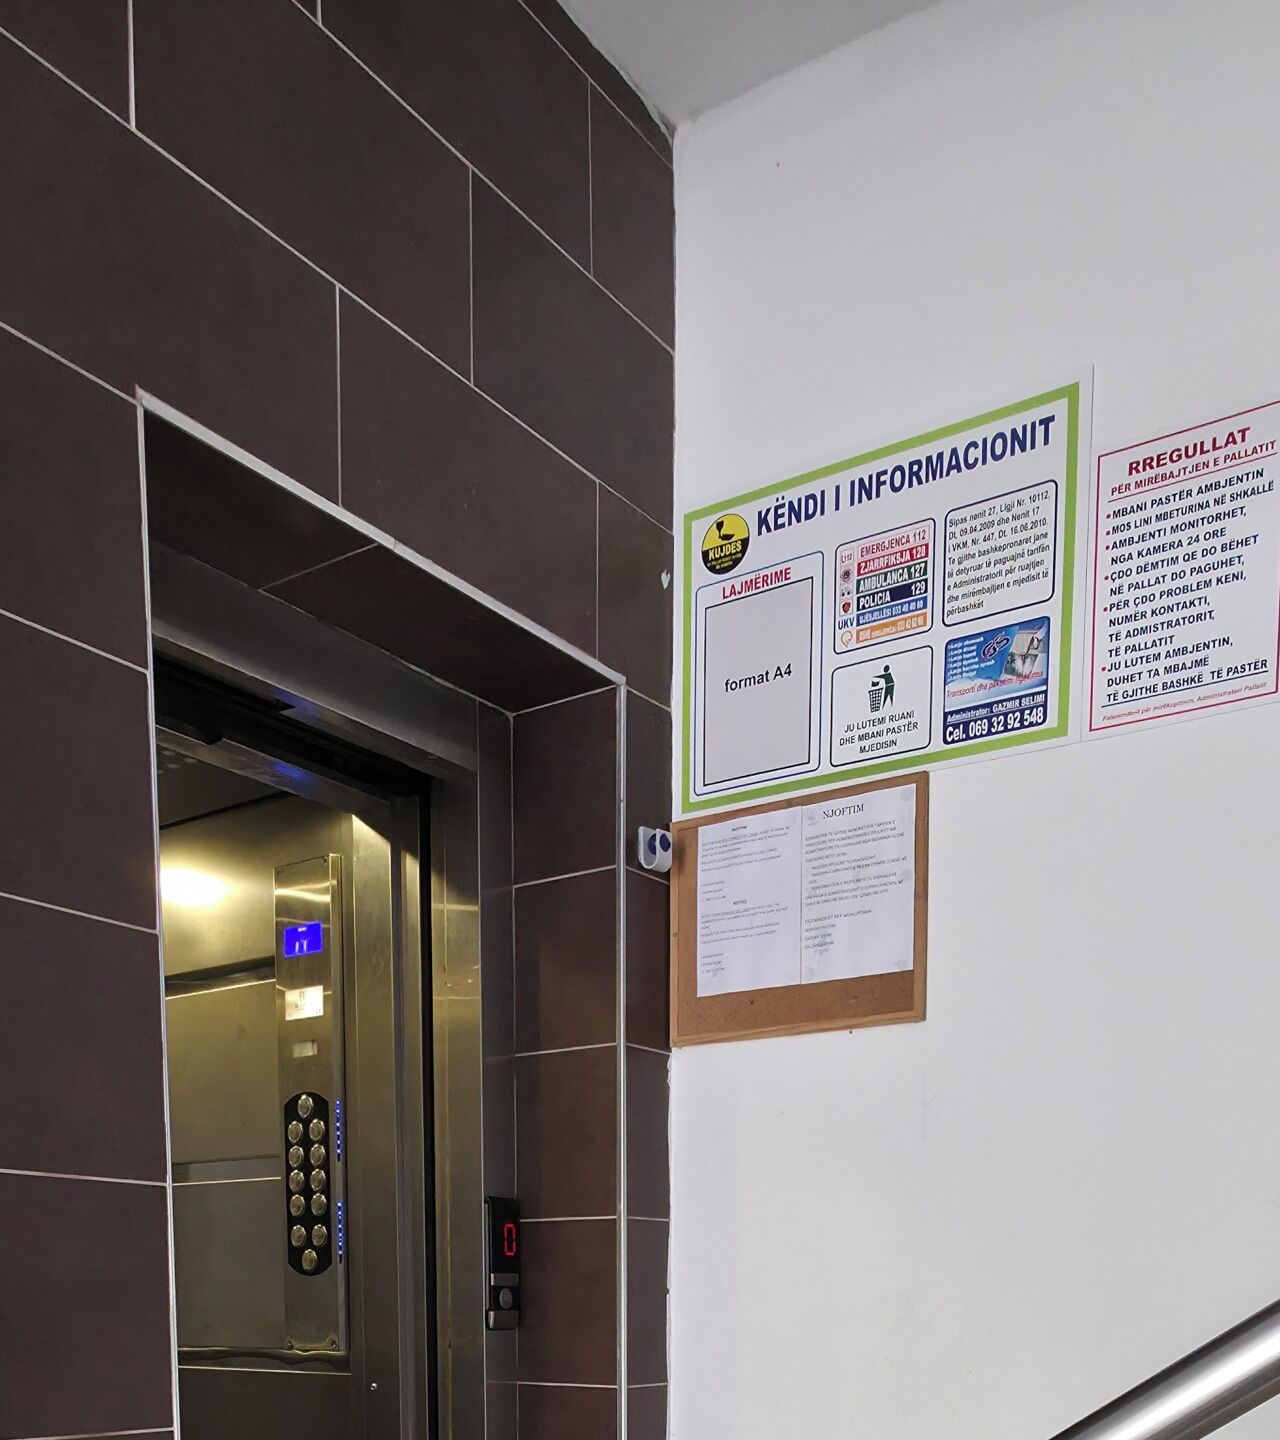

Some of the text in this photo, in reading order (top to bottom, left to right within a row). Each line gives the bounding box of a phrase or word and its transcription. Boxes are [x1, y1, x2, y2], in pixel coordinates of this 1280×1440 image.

[1127, 426, 1251, 477] RREGULLAT
[757, 414, 1056, 537] KËNDI I INFORMACIONIT
[1111, 439, 1277, 497] PËR MIRËBAJTJEN E PALLATIT
[1111, 480, 1274, 536] MOS LINI MBETURINA NË SHKALLË
[1112, 467, 1264, 520] MBANI PASTËR AMBJENTIN
[948, 515, 968, 528] Sipas
[969, 508, 987, 522] nenit
[959, 520, 996, 538] 09.04.2009
[997, 516, 1010, 527] dhe
[1011, 510, 1030, 523] Nenit
[1032, 506, 1040, 517] 17
[1111, 505, 1247, 551] AMBJENTI MONITORHET,
[709, 540, 742, 561] KUJDES
[860, 529, 926, 558] EMERGJENCA 112
[1032, 531, 1049, 545] jane
[1110, 527, 1227, 566] NGA KAMERA 24 ORE
[955, 561, 984, 577] detyruar
[993, 549, 1026, 567] paguajnë
[1004, 564, 1017, 578] për
[1110, 534, 1259, 583] ÇDO DËMTIM QE DO BËHET
[722, 566, 792, 600] LAJMËRIME
[859, 562, 925, 593] AMBULANCA 127
[946, 593, 960, 604] dhe
[1041, 567, 1049, 579] të
[1109, 554, 1245, 597] NË PALLAT DO PAGUHET,
[1109, 570, 1247, 612] PËR ÇDO PROBLEM KENI,
[859, 581, 926, 610] POLICIA 129
[946, 598, 984, 618] përbashkët
[1108, 595, 1210, 628] NUMËR KONTAKTI,
[837, 617, 856, 630] UKV
[1108, 609, 1215, 643] TË ADMISTRATORIT,
[1107, 636, 1233, 673] JU LUTEM AMBJENTIN,
[1108, 634, 1175, 659] TË PALLATIT
[725, 663, 792, 692] format A4
[977, 683, 988, 692] dhe
[1106, 659, 1268, 703] TË GJITHE BASHKË TË PASTËR
[1107, 656, 1210, 688] DUHET TA MBAJMË
[844, 710, 915, 733] JU LUTEMI RUANI
[947, 693, 1045, 722] Administrator: GAZMIR SELIMI
[839, 721, 919, 747] DHE MBANI PASTËR
[946, 707, 1044, 742] Cel. 069 32 92 548
[859, 739, 898, 754] MJEDISIN
[822, 803, 864, 820] NJOFTIM
[504, 1223, 517, 1257] 0
